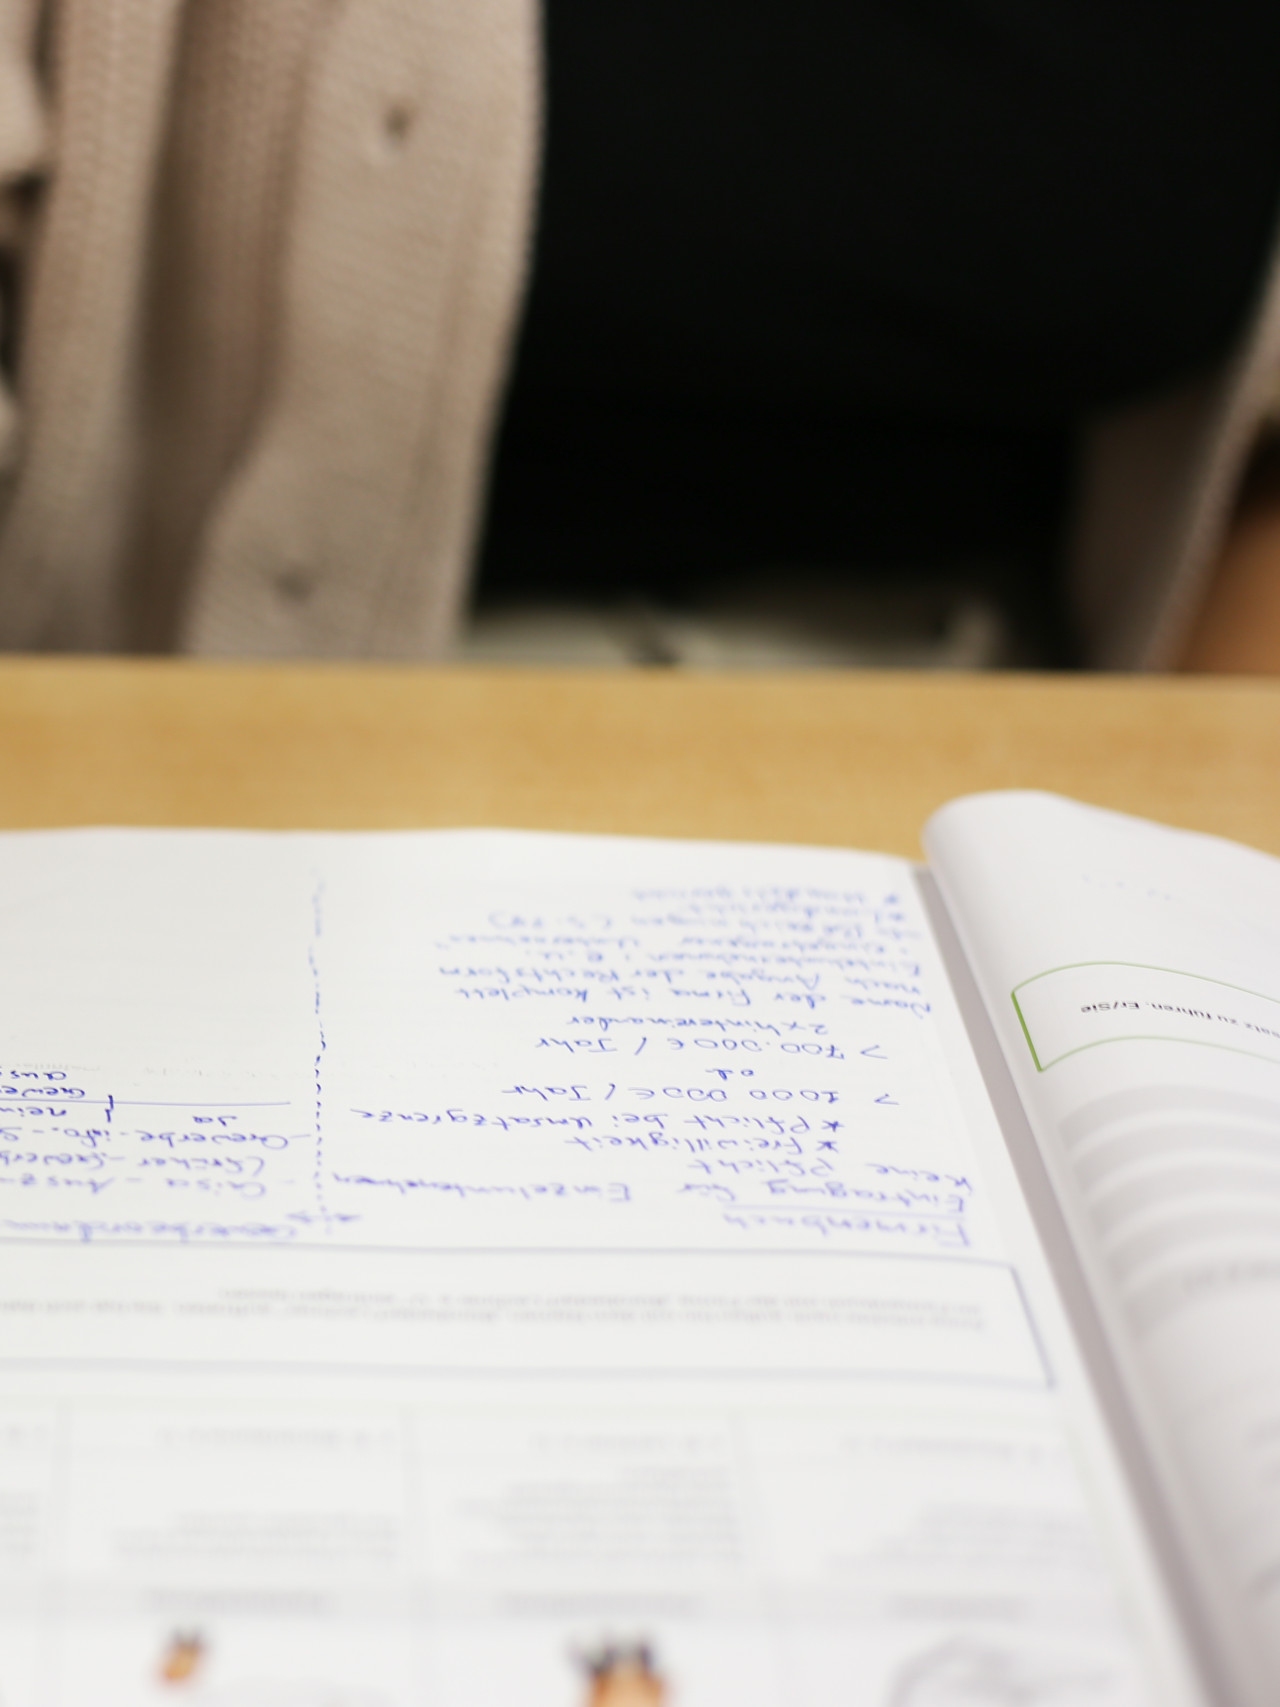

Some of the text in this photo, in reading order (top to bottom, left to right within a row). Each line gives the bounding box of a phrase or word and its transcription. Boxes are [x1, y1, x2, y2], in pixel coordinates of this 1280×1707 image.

[838, 995, 932, 1020] Name
[1080, 1001, 1139, 1013] Er/Sie
[534, 1036, 618, 1055] Jahr
[500, 1084, 592, 1102] Jahr
[611, 1112, 669, 1131] bei
[683, 1115, 811, 1136] Pflicht
[688, 1157, 834, 1177] Pflicht
[762, 1179, 965, 1214] Eintragung
